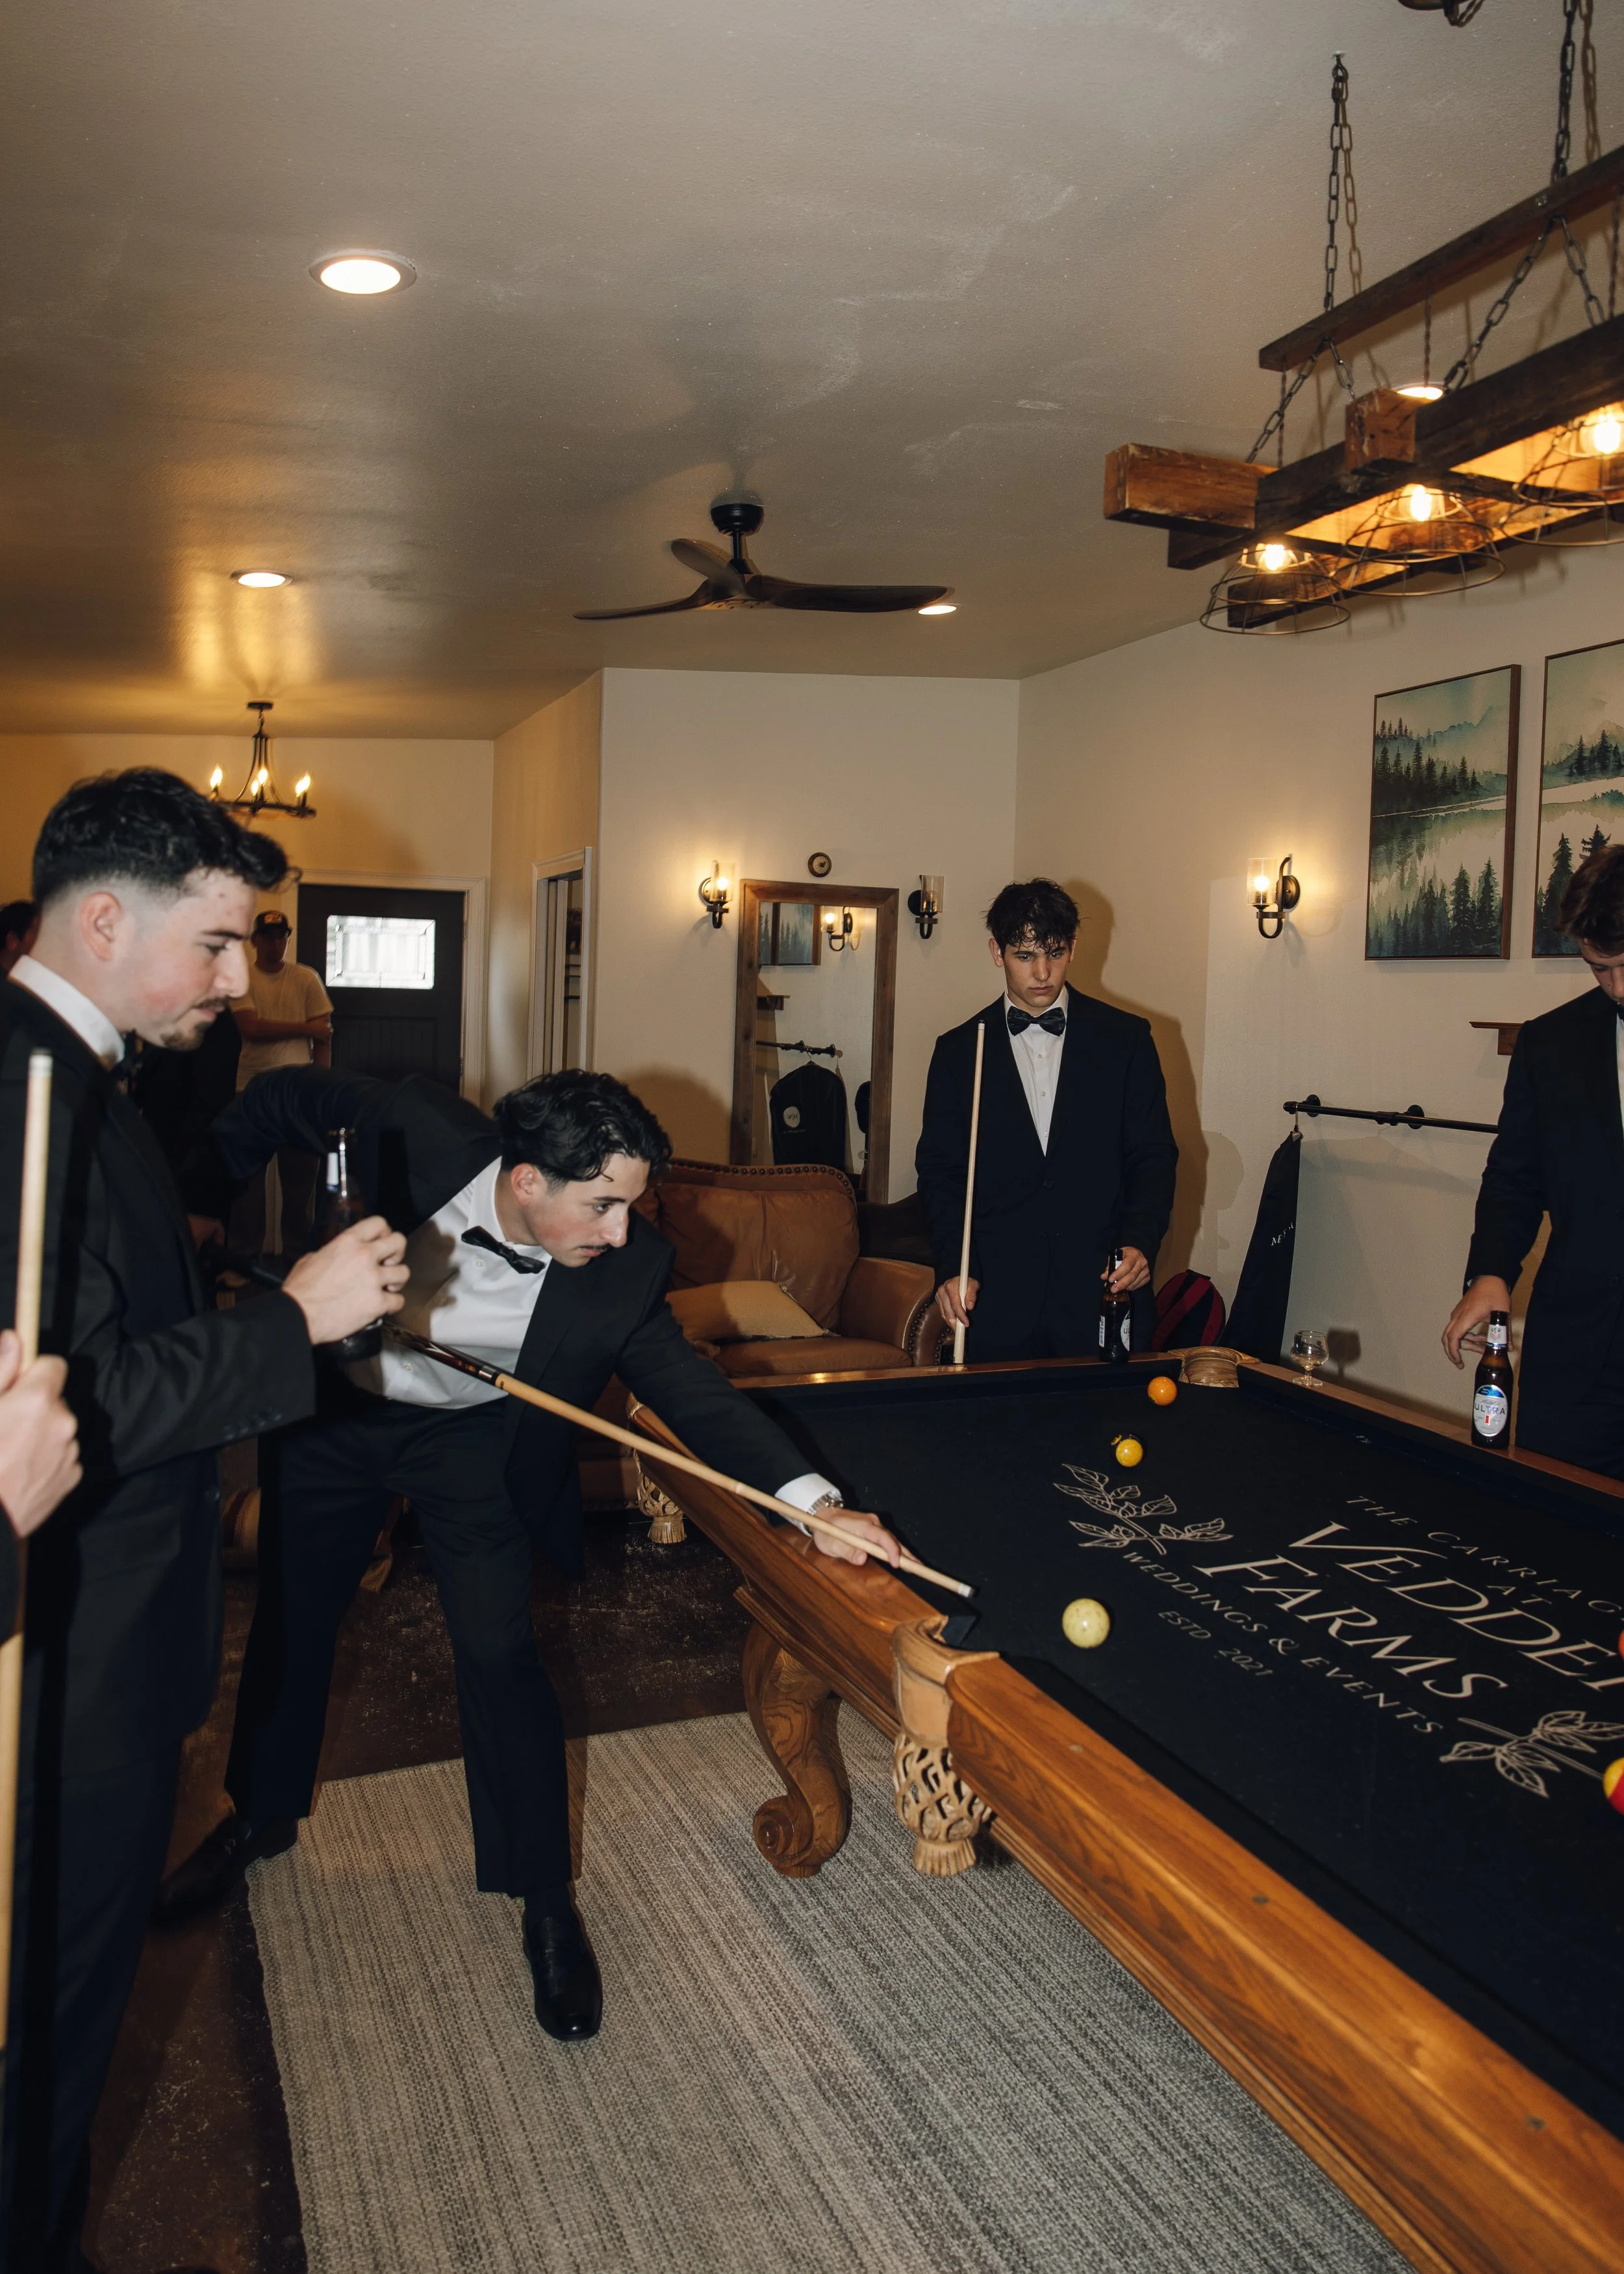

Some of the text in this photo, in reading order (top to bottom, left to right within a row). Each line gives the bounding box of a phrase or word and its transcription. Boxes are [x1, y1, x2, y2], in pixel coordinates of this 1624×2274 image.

[1475, 1403, 1505, 1415] ULTRA
[1347, 1495, 1624, 1621] THE CARRIAG
[1487, 1584, 1552, 1605] AT
[1123, 1551, 1443, 1734] WEDDINGS & EVENTS
[1158, 1610, 1274, 1677] ESTD 2021
[1193, 1555, 1509, 1699] FARMS
